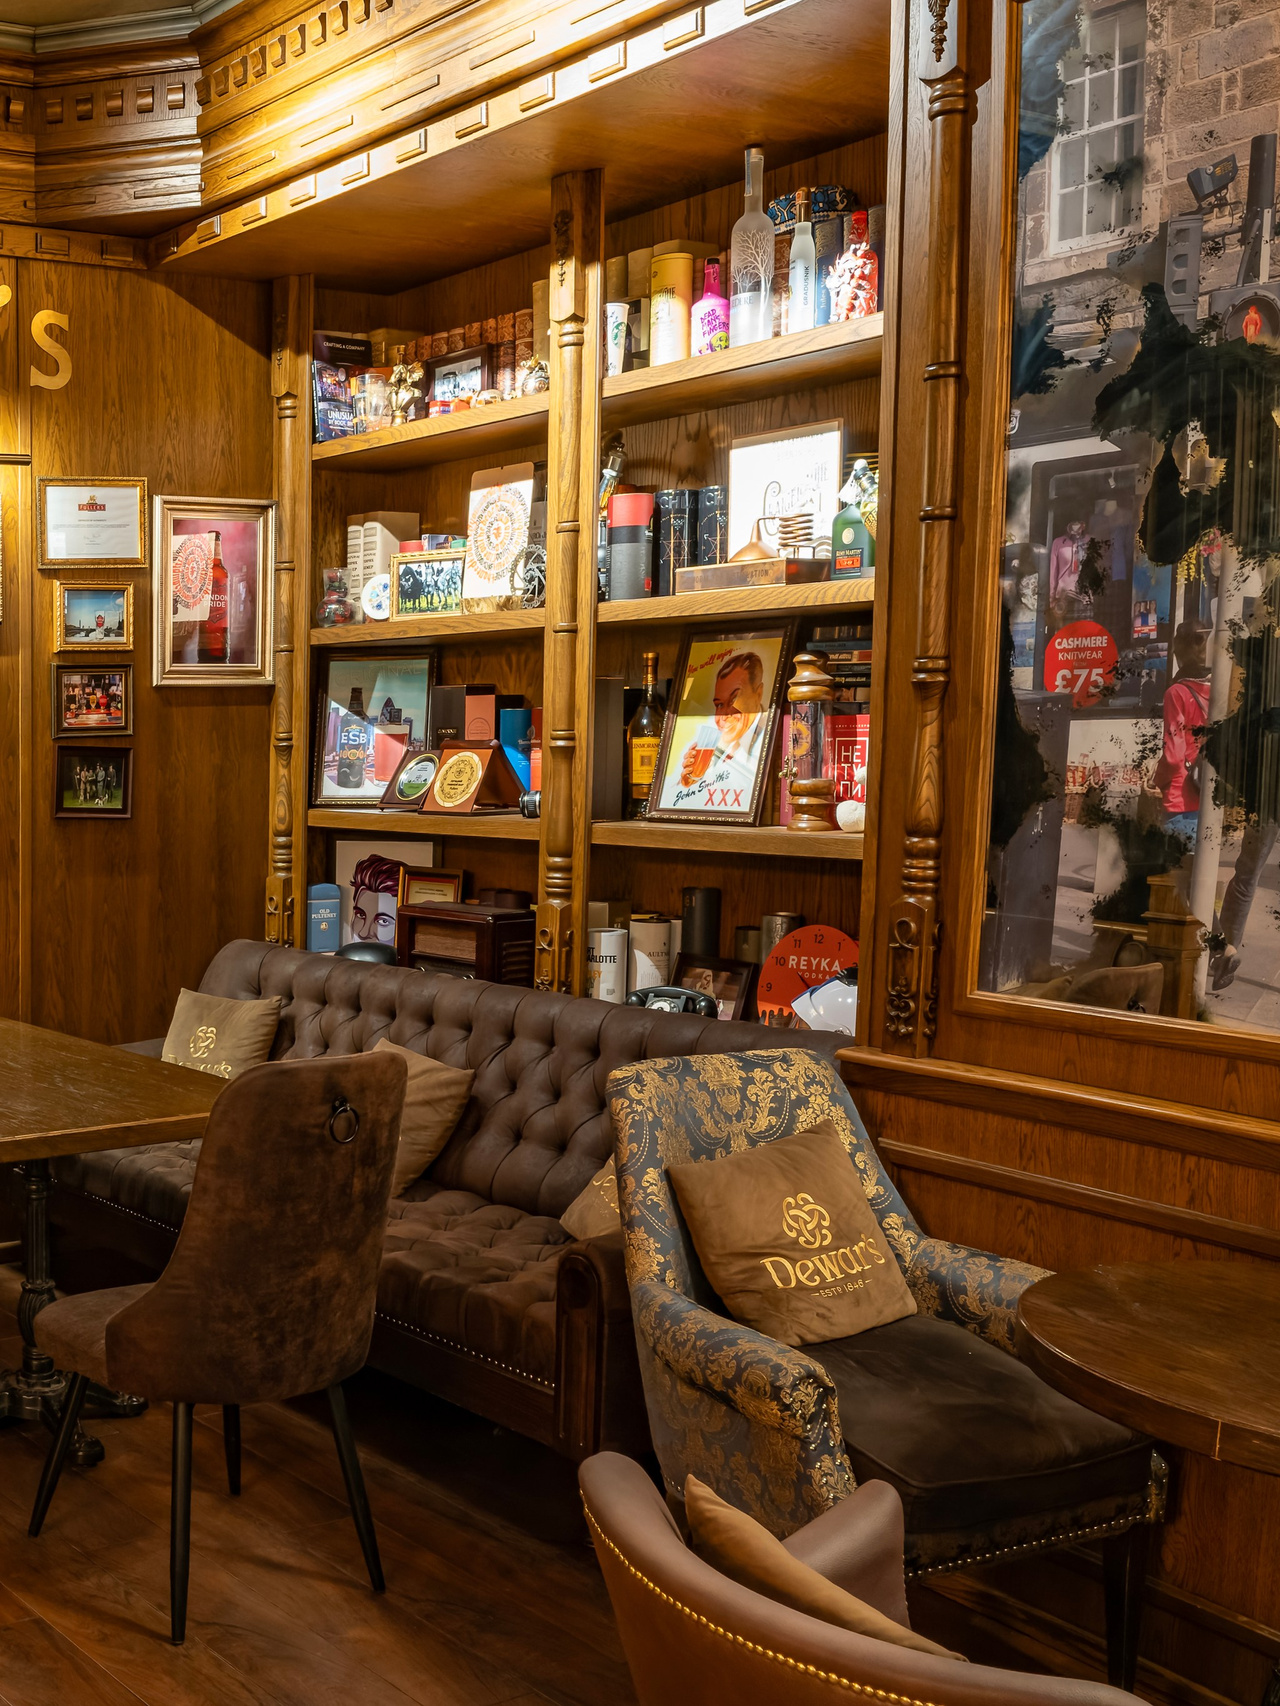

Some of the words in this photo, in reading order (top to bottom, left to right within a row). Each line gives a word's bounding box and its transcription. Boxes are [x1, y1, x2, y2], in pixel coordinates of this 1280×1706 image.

[700, 308, 717, 324] DEAD
[702, 322, 730, 338] FINGERS
[328, 410, 354, 419] UNUSUA
[1055, 636, 1108, 649] CASHMERE
[1058, 650, 1102, 660] KNITWEAR
[700, 655, 716, 670] will
[1055, 668, 1105, 693] £75
[341, 731, 367, 745] ESB
[841, 746, 861, 762] НЕ
[673, 790, 696, 807] John
[698, 770, 730, 789] Smith's
[840, 781, 861, 797] ПИ
[704, 789, 744, 807] XXX
[794, 939, 801, 948] 11
[814, 934, 824, 944] 12
[838, 942, 841, 951] 1
[586, 955, 617, 963] ARLOTTE
[775, 956, 786, 966] 10
[788, 956, 841, 972] REYKA
[766, 983, 772, 992] 9
[760, 1234, 886, 1289] Dewar's
[844, 1280, 864, 1293] 1846
